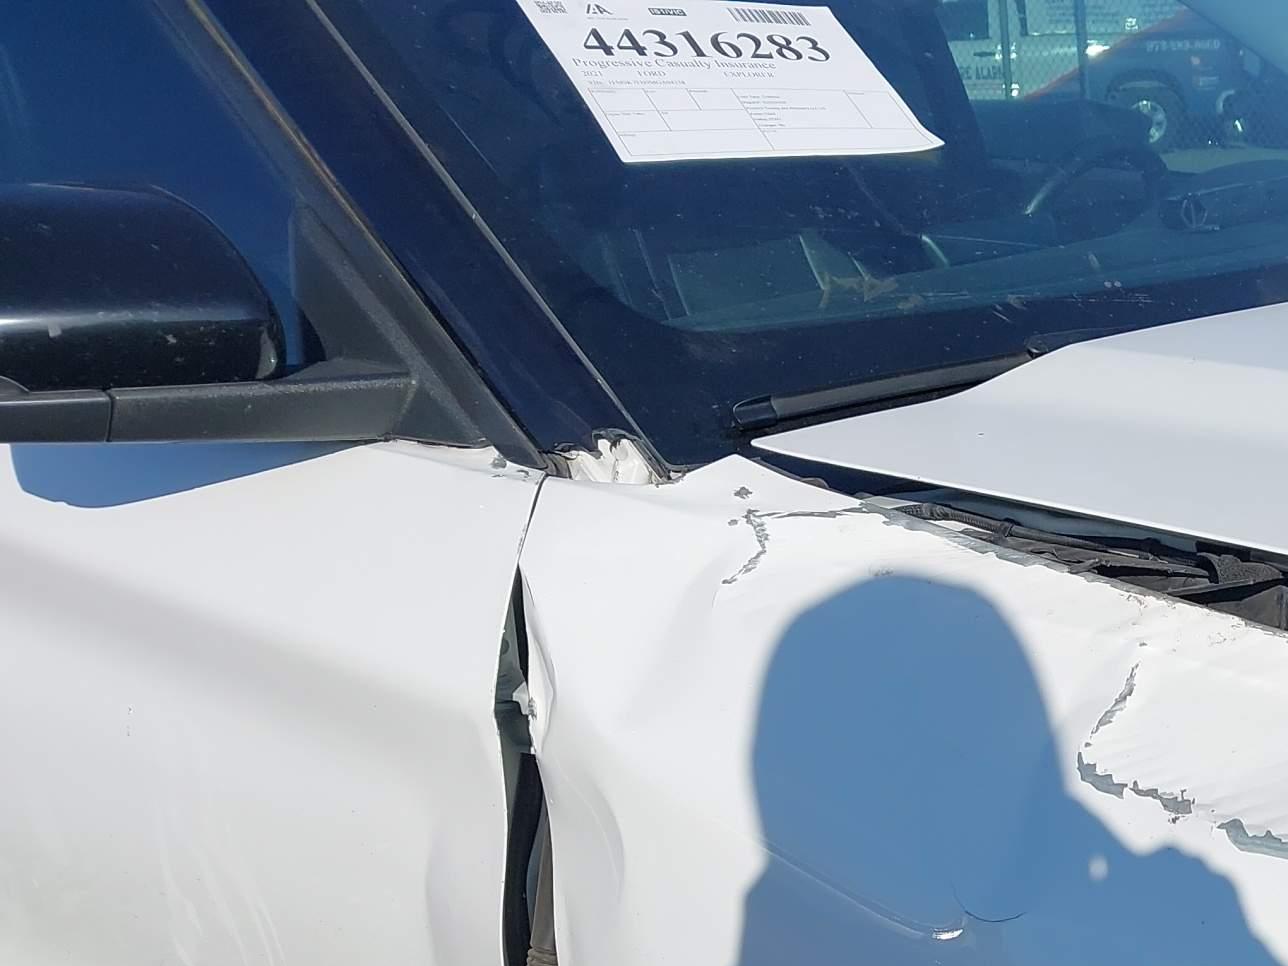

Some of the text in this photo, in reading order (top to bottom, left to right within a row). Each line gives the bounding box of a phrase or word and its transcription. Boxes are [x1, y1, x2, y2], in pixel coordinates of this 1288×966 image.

[583, 27, 831, 62] 44316283
[573, 57, 776, 70] Progressive Casualty Insurance
